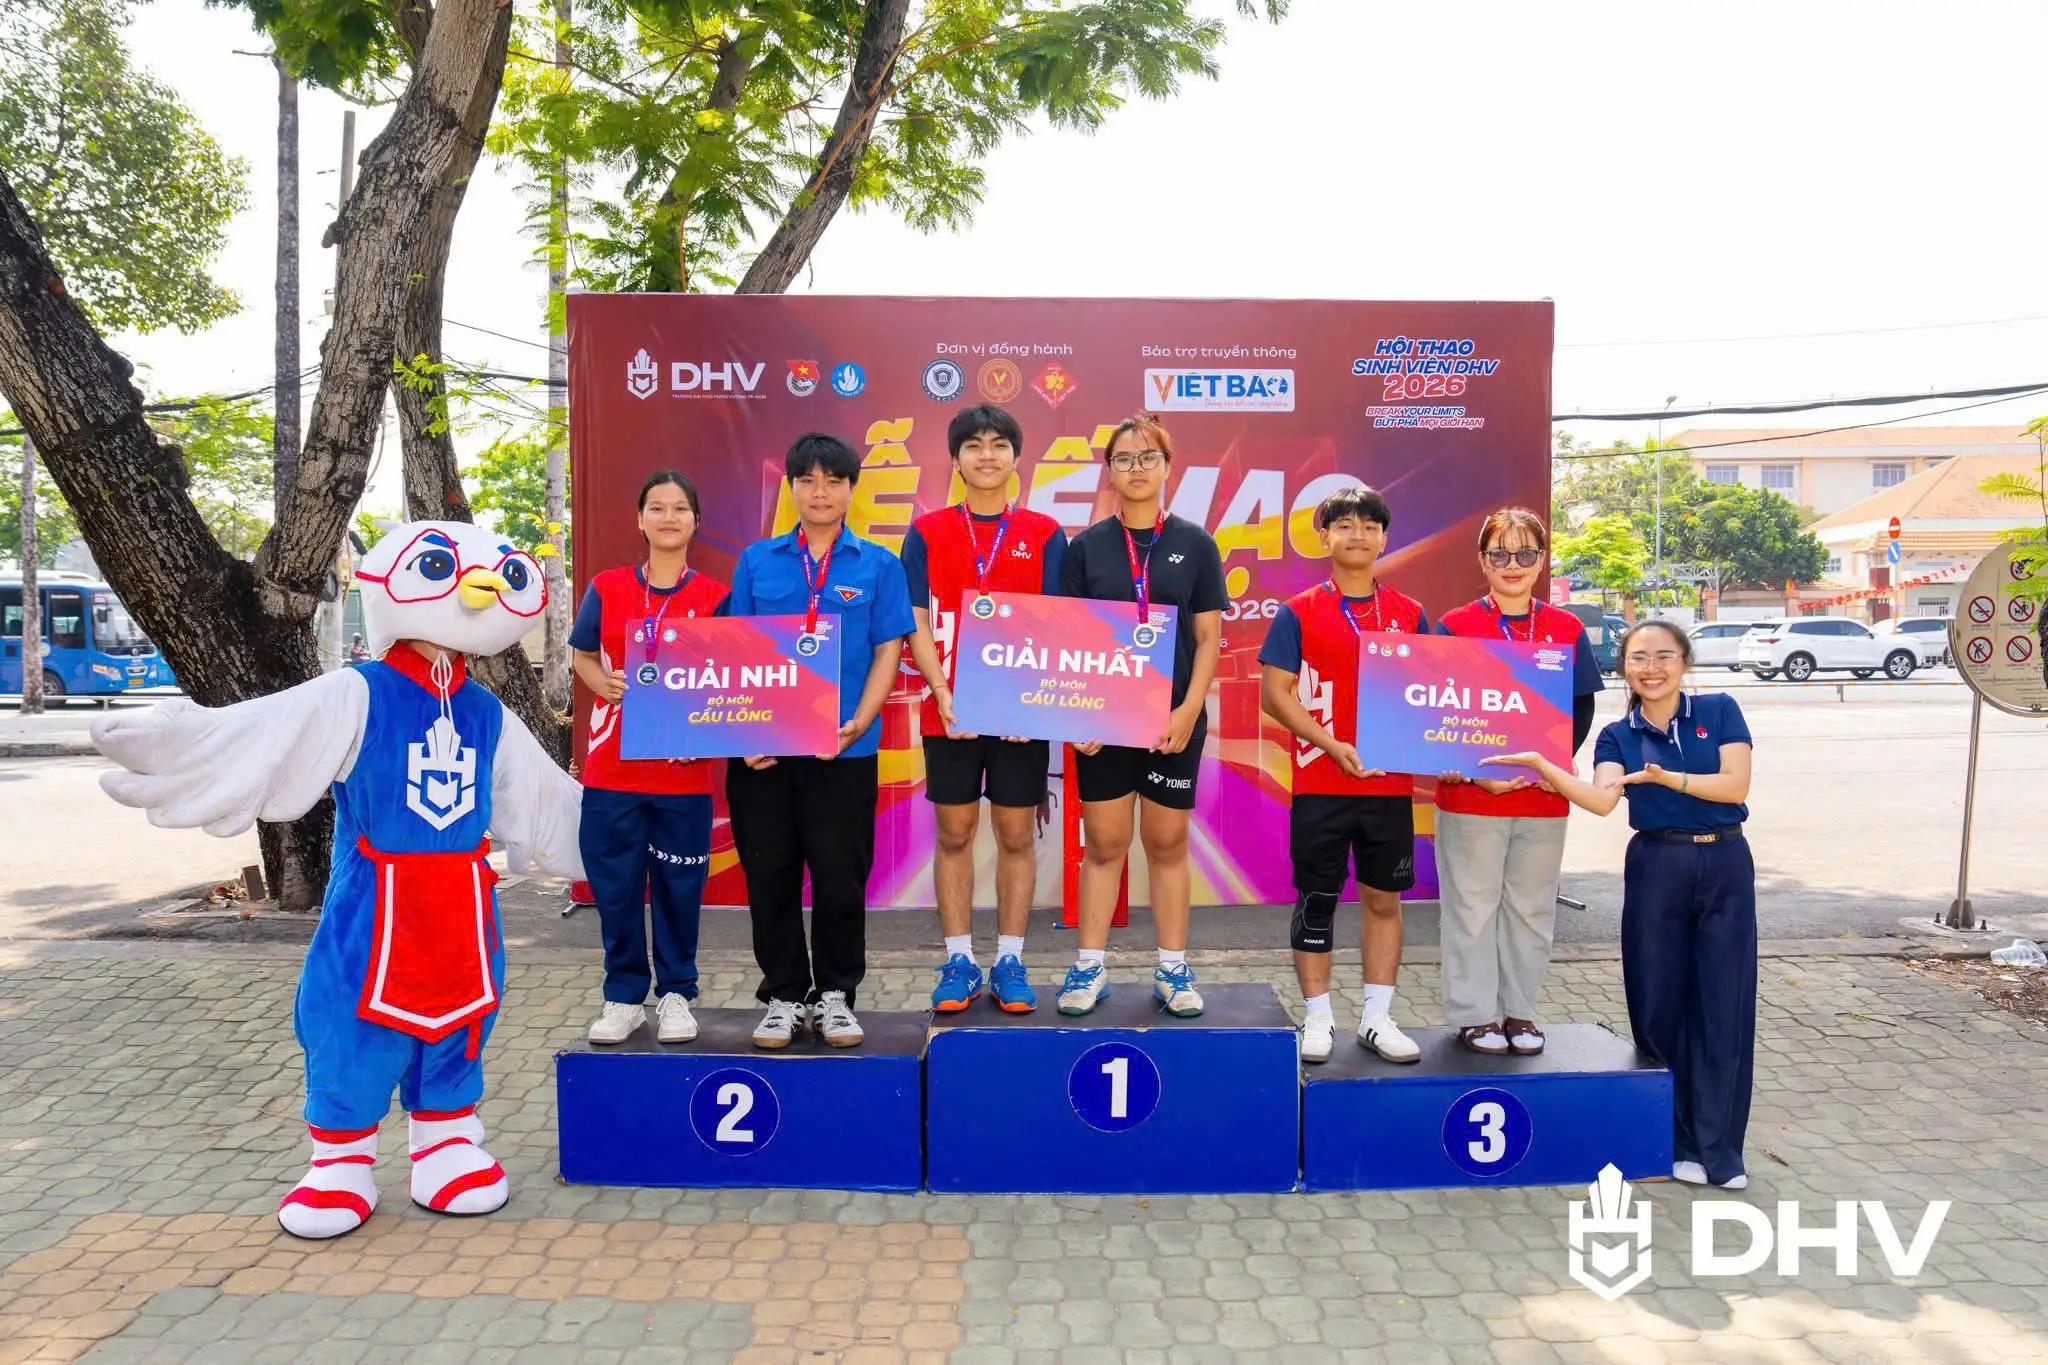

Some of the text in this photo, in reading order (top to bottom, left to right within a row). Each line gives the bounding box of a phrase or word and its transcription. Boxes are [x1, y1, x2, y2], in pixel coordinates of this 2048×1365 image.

[936, 342, 1072, 357] Đơn vị đồng hành
[1142, 345, 1297, 359] Bảo trợ truyền thông
[1375, 336, 1474, 359] HỘI THAO
[1352, 357, 1500, 376] SINH VIÊN DHV
[671, 363, 766, 391] DHV
[1383, 374, 1466, 401] 2026
[1366, 406, 1465, 416] BREAK YOUR LIMITS
[1397, 416, 1419, 427] PHÁ
[1461, 417, 1484, 430] HẠN
[1012, 549, 1032, 559] DHV
[1221, 598, 1280, 621] 026
[982, 638, 1150, 678] GIẢI NHẤT
[664, 659, 729, 690] GIẢI
[741, 659, 798, 687] NHÌ
[1040, 678, 1087, 690] BỘ MÔN
[707, 695, 753, 707] BỘ MÔN
[1020, 690, 1105, 709] CẦU LÔNG
[1405, 678, 1527, 713] GIẢI BA
[688, 708, 773, 724] CẦU LÔNG
[1442, 715, 1488, 728] BỘ MÔN
[1423, 726, 1508, 747] CẦU LÔNG
[1166, 778, 1191, 789] YONEX
[1101, 1057, 1128, 1118] 1
[716, 1082, 754, 1142] 2
[1468, 1102, 1506, 1164] 3
